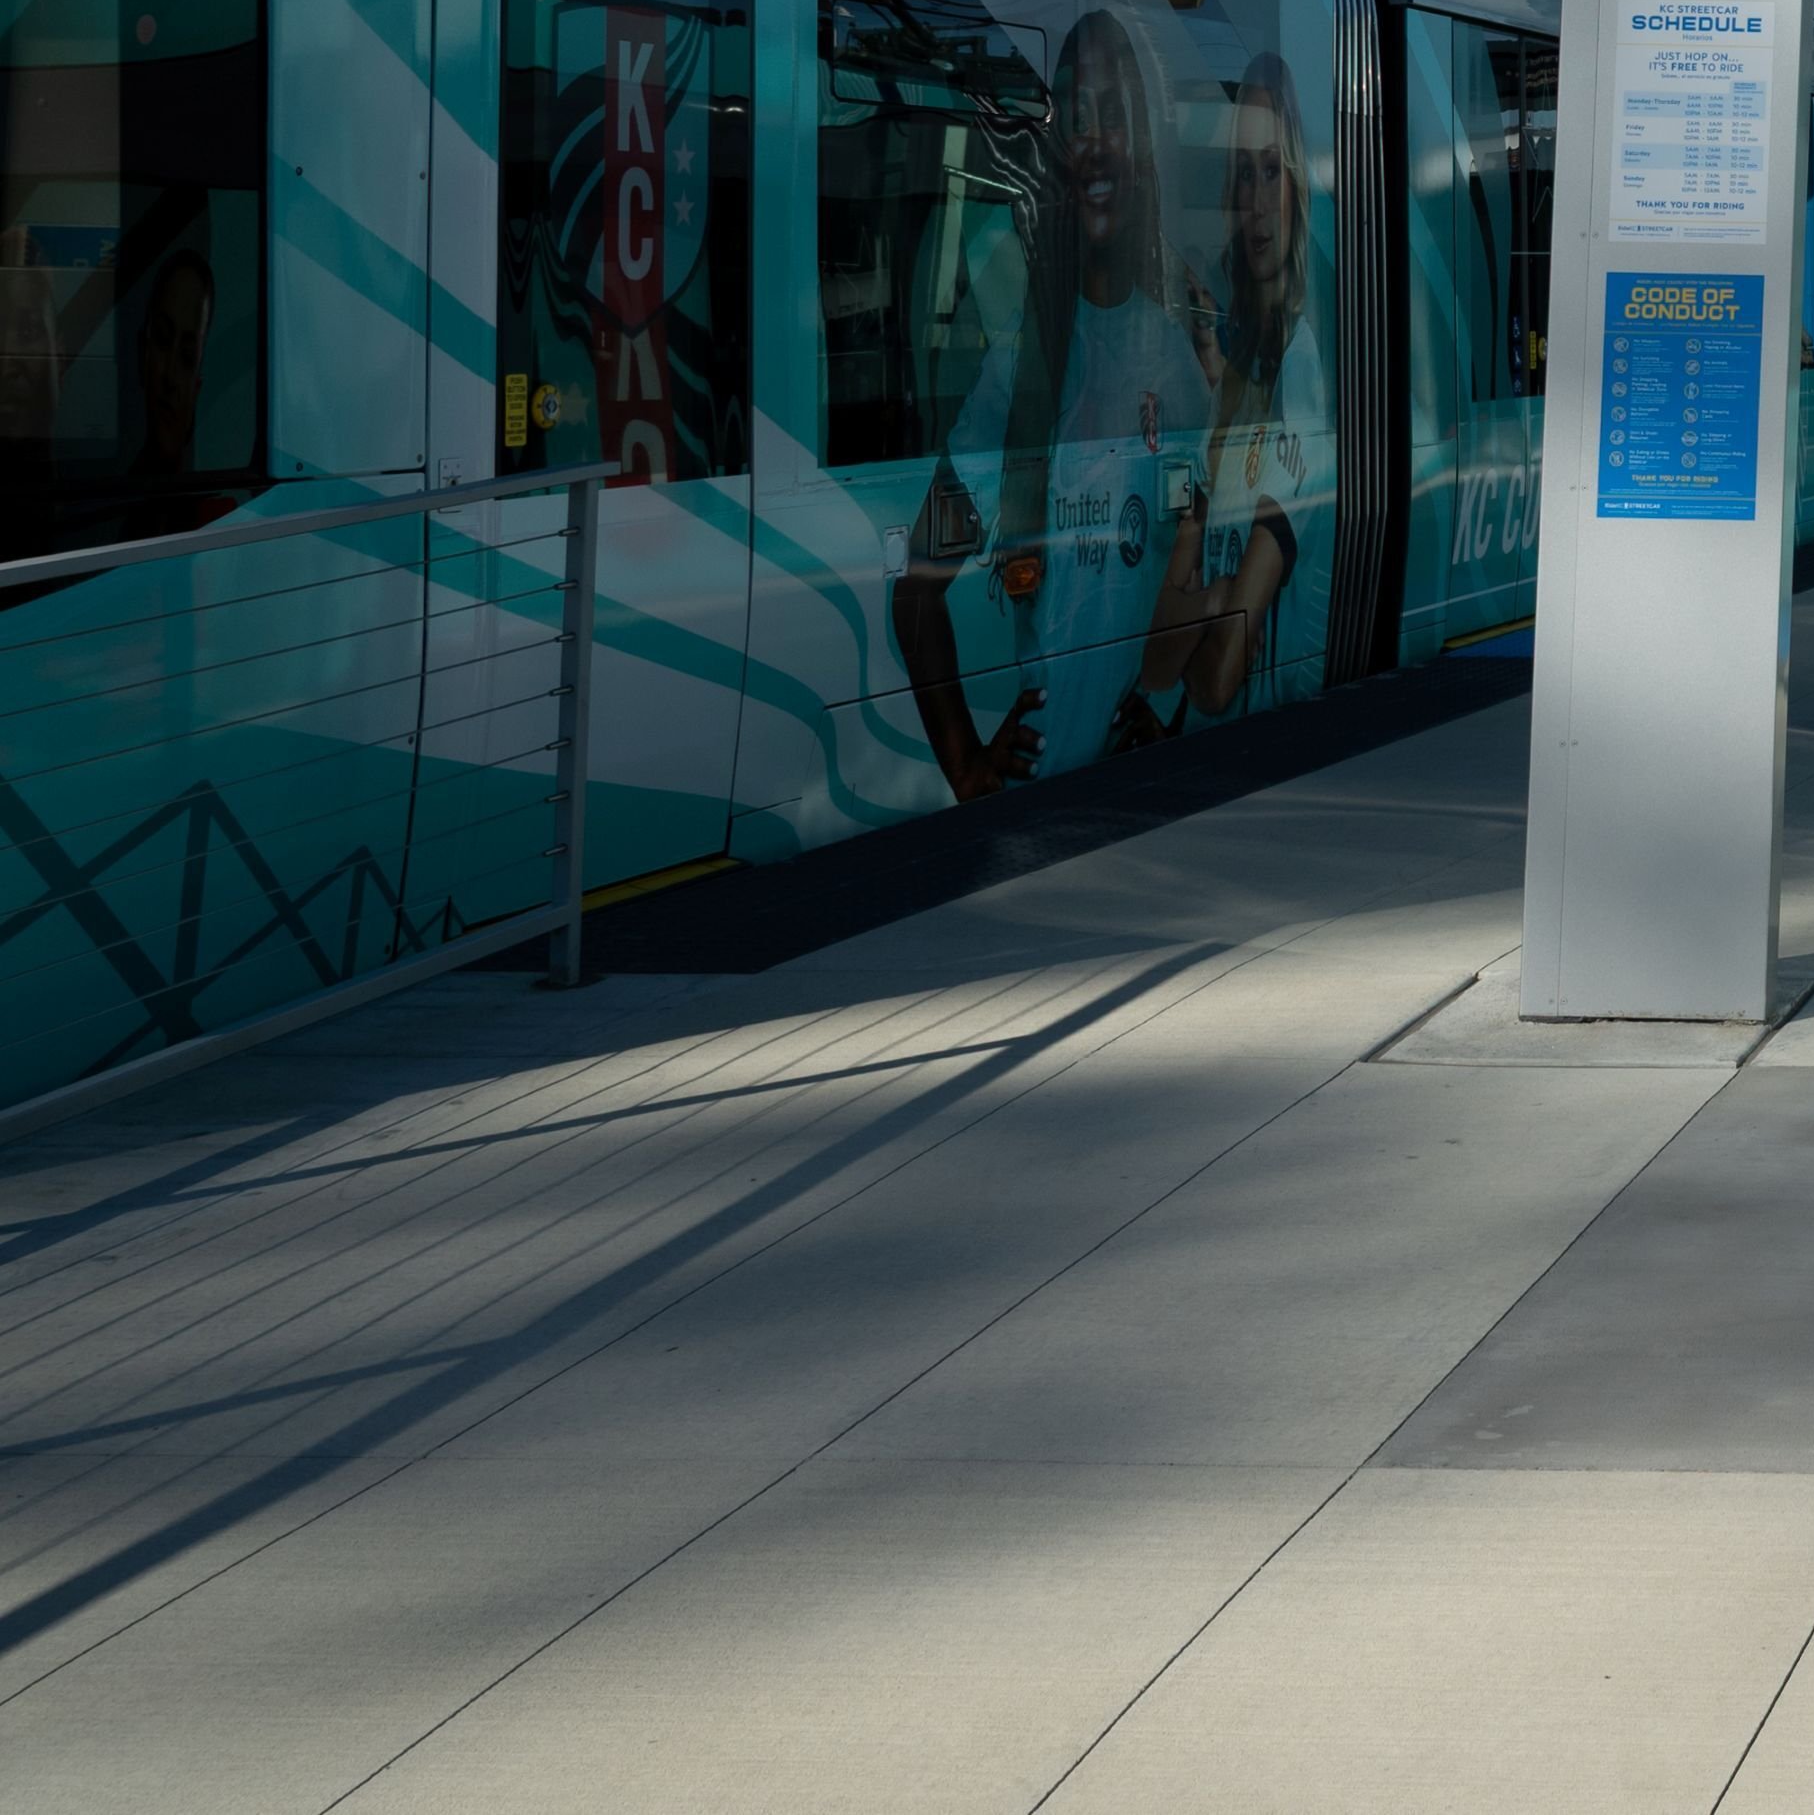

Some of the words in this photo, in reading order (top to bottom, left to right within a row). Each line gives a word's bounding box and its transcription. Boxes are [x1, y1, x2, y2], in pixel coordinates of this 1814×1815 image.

[1659, 5, 1674, 14] KC
[1678, 5, 1739, 15] STREETCAR
[1632, 15, 1763, 33] SCHEDULE
[1654, 52, 1681, 61] JUST
[1685, 53, 1708, 61] HOP
[1649, 62, 1667, 71] IT'S
[1671, 62, 1697, 71] FREE
[1701, 63, 1716, 72] TO
[1720, 63, 1744, 73] RIDE
[1636, 200, 1666, 208] THANK
[1692, 201, 1710, 209] FOR
[1713, 202, 1744, 210] RIDING
[1632, 287, 1697, 303] CODE
[1703, 288, 1735, 304] OF
[1625, 304, 1740, 321] CONDUCT
[1276, 432, 1307, 498] ally
[1055, 491, 1111, 532] United
[1452, 468, 1497, 566] KC
[1075, 534, 1110, 574] Way
